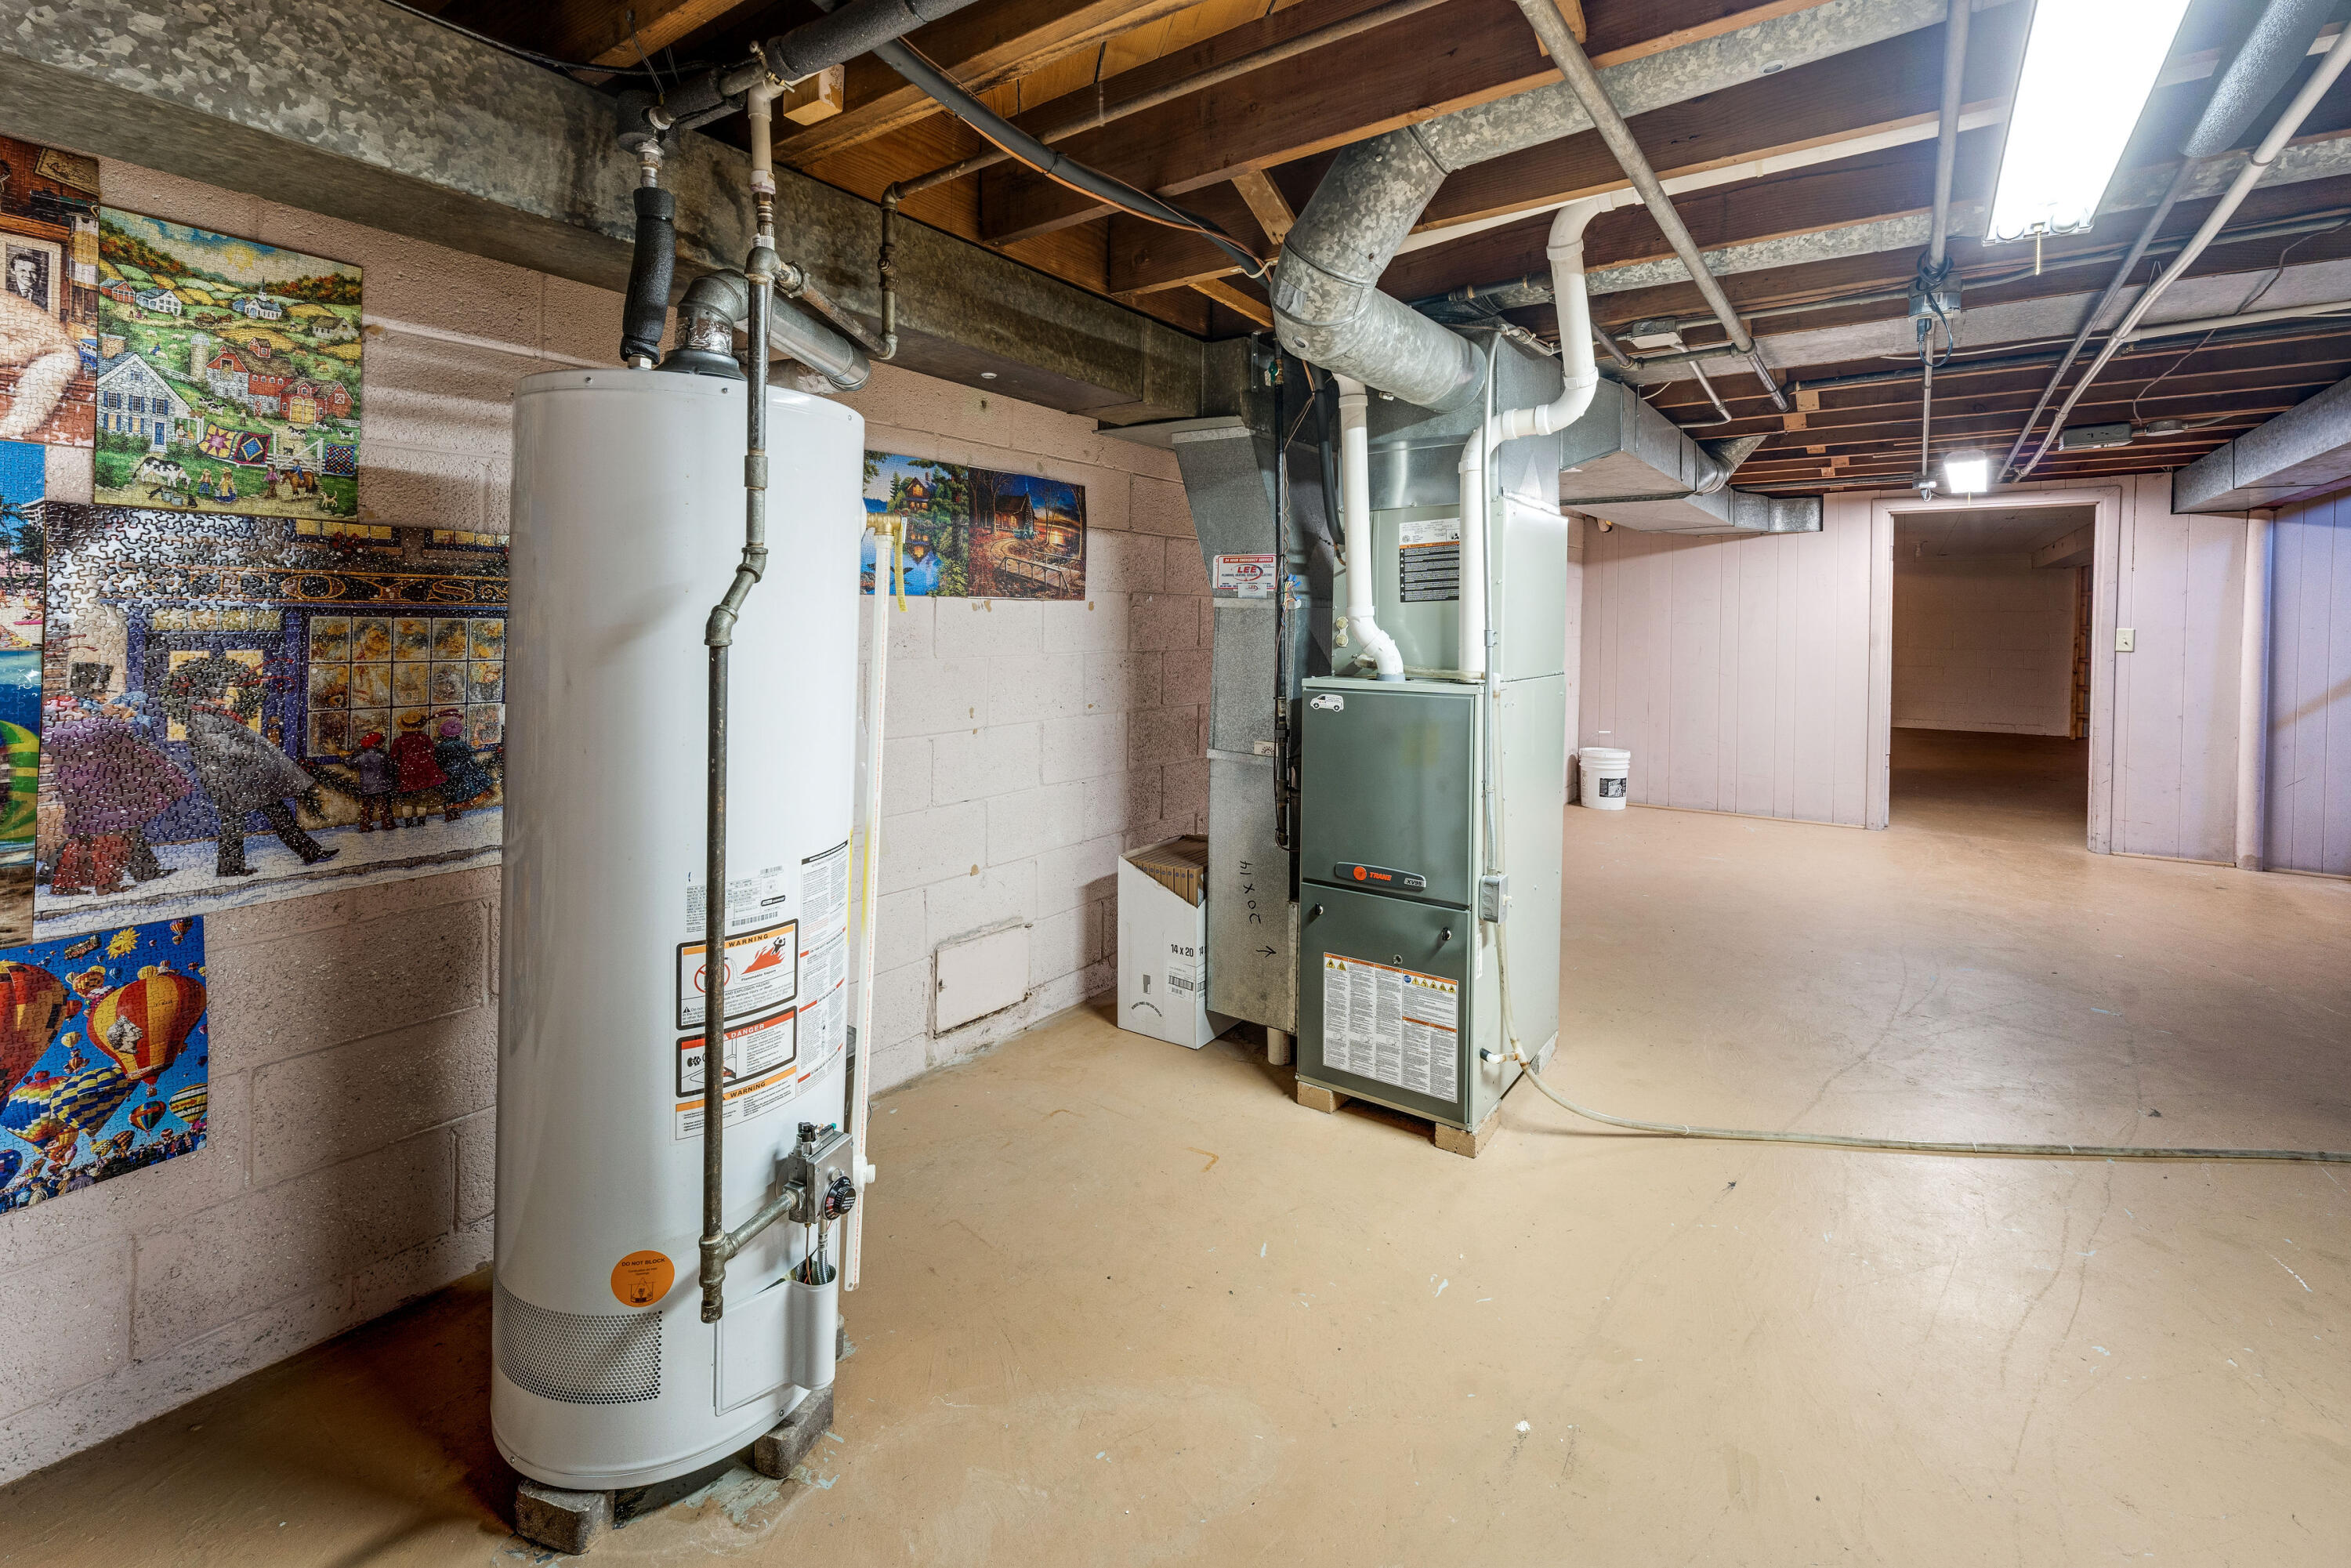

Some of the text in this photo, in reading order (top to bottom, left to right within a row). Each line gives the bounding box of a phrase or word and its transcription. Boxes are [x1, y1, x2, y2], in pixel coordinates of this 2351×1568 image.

[190, 570, 476, 603] TOYS
[1240, 860, 1253, 875] 14
[1369, 871, 1392, 882] TRANE
[1247, 900, 1262, 925] 20
[728, 933, 769, 947] WARNING
[1171, 943, 1194, 957] 14 x 20
[741, 973, 763, 982] Flammable
[734, 986, 755, 994] EXPLOSION
[731, 1023, 765, 1038] DANGER
[730, 1081, 766, 1098] WARNING
